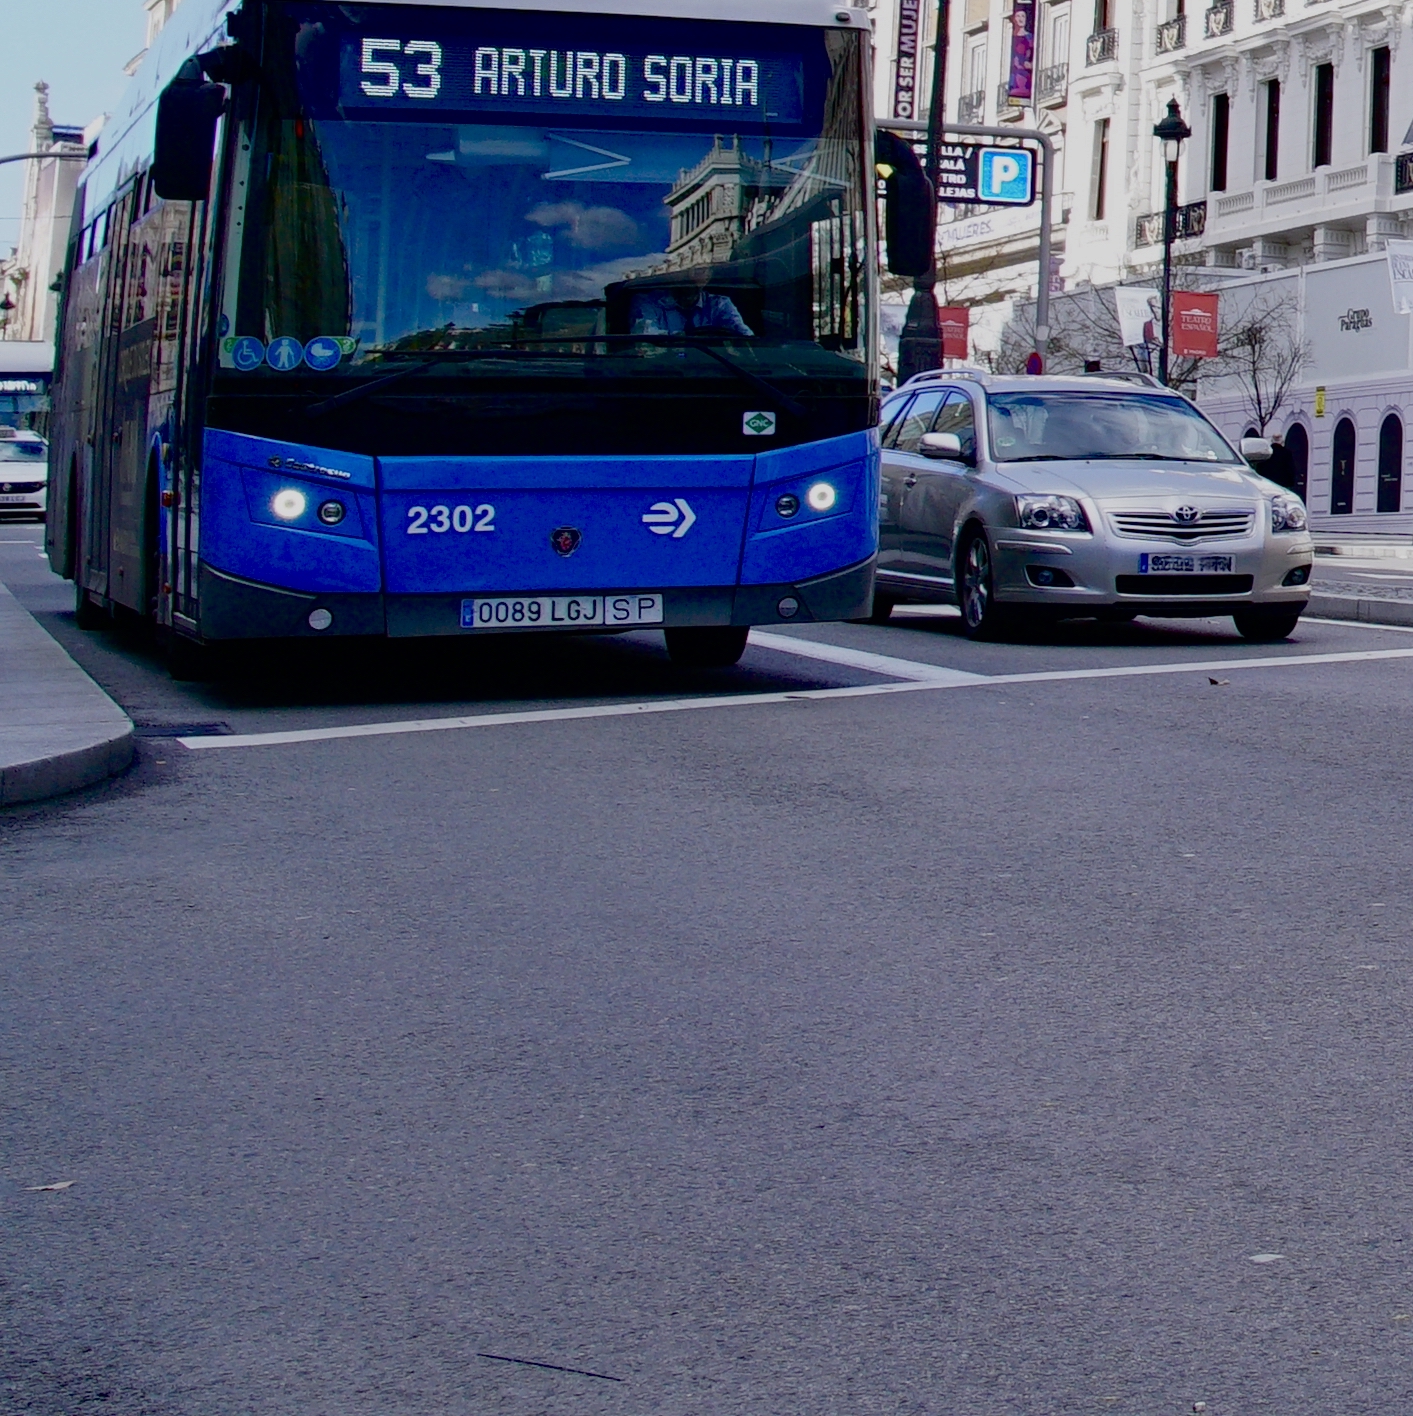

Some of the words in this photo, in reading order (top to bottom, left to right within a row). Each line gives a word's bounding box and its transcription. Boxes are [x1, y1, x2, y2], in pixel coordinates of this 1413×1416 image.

[361, 37, 442, 98] 53
[475, 46, 626, 100] ARTURO
[643, 55, 759, 105] SORIA
[897, 56, 915, 87] SER
[1347, 308, 1370, 322] Grupo
[750, 418, 769, 428] GNC
[406, 503, 495, 534] 2302
[478, 601, 541, 623] 0089
[551, 599, 597, 622] LGJ
